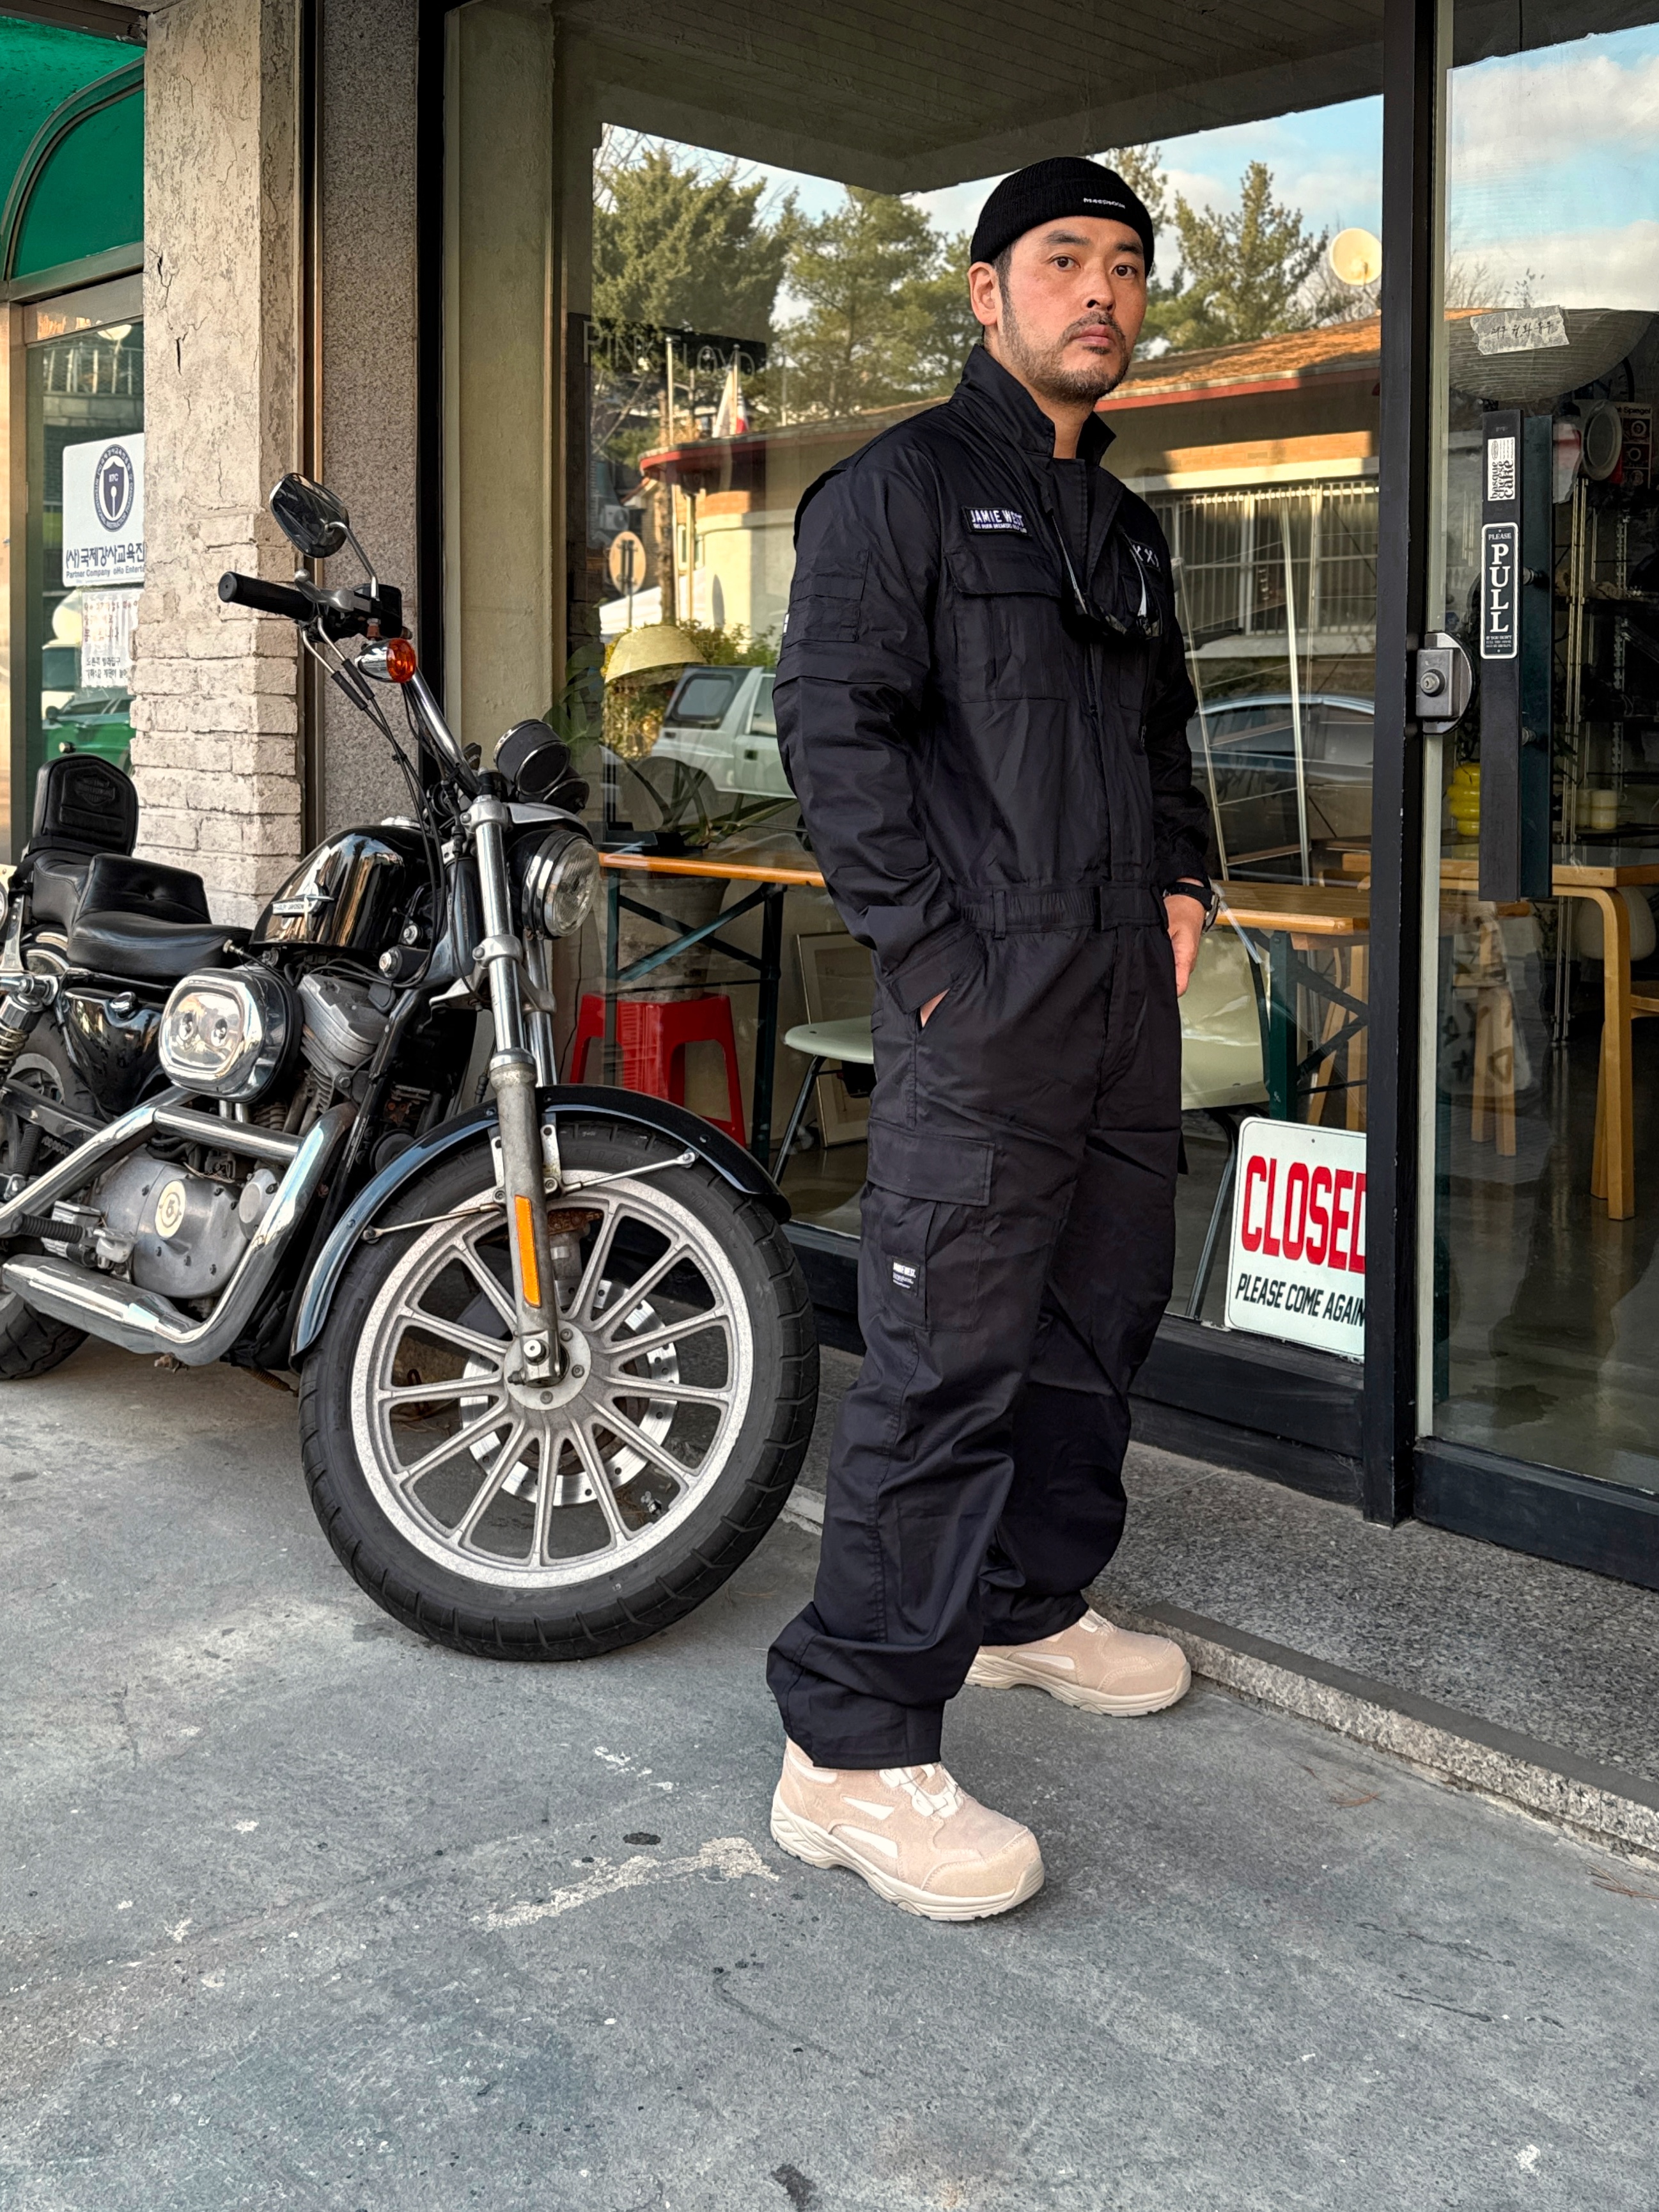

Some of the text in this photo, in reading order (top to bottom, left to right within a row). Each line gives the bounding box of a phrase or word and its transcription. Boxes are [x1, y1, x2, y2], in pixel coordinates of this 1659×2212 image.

[582, 320, 659, 373] PINK
[1490, 461, 1500, 499] basque
[1493, 460, 1505, 499] cheese
[1499, 460, 1514, 498] cake
[970, 510, 1002, 523] JAMIE
[66, 570, 85, 579] Partner
[86, 569, 111, 577] Company
[1490, 543, 1511, 632] PULL
[1242, 1155, 1366, 1275] CLOSED
[1235, 1273, 1366, 1327] PLEASE COME AGAIN
